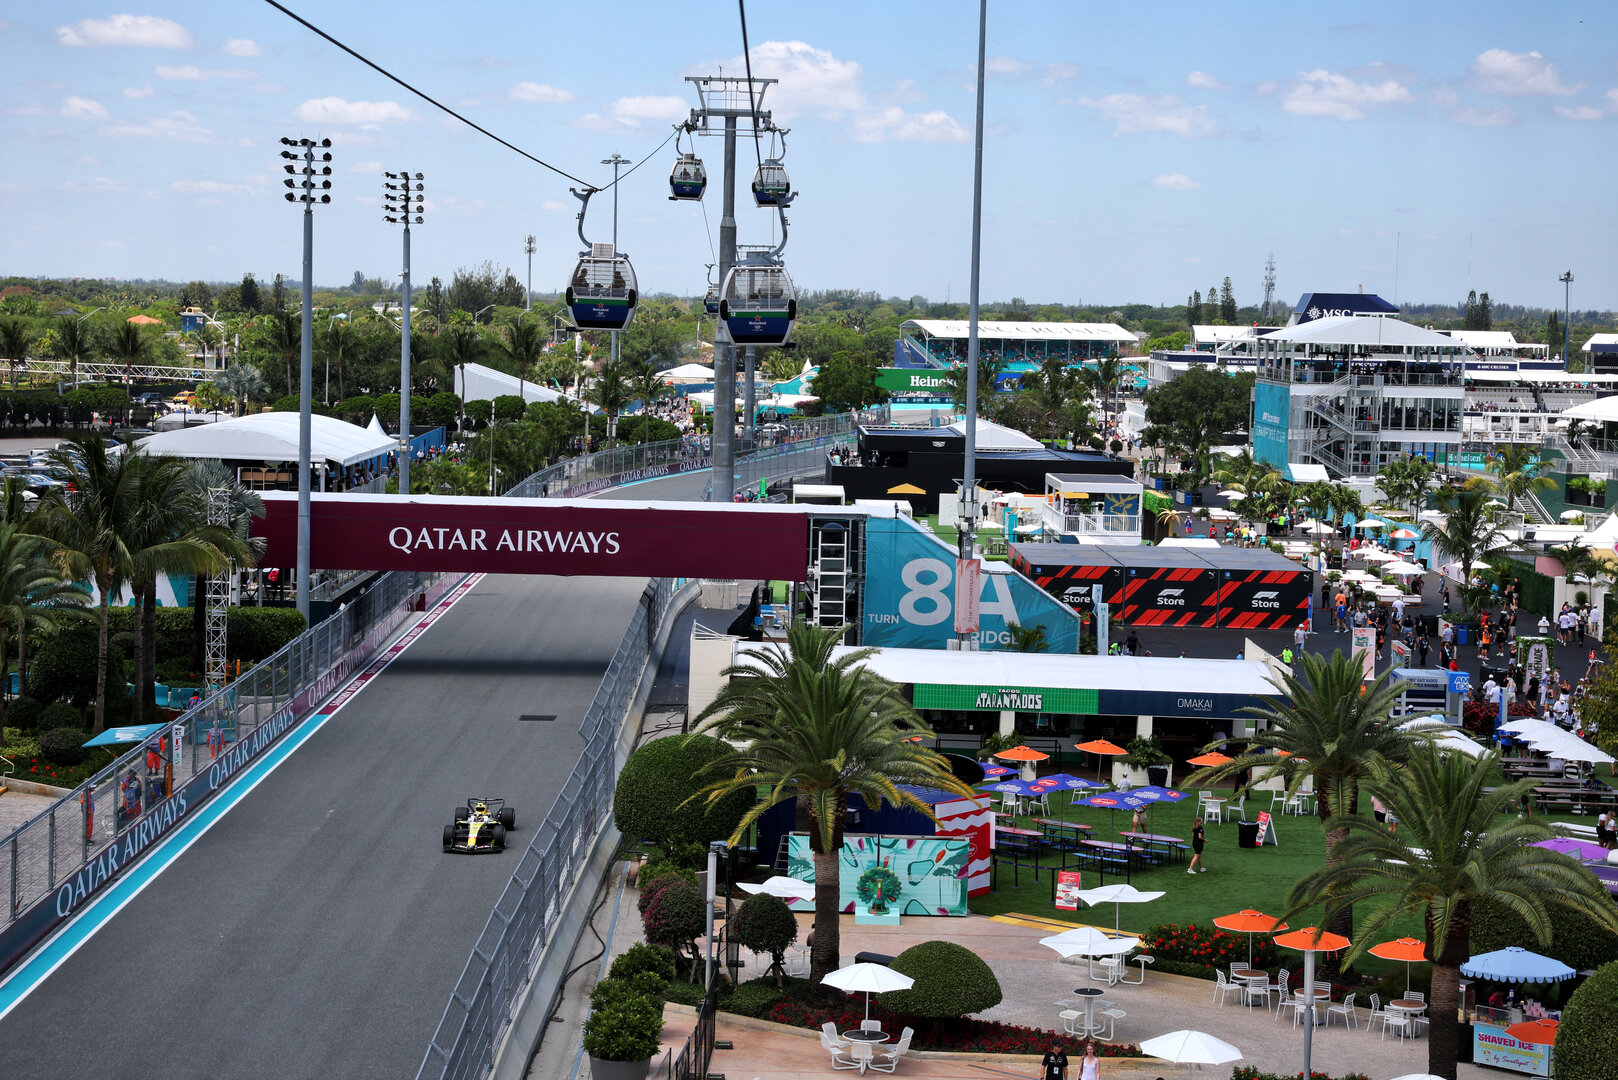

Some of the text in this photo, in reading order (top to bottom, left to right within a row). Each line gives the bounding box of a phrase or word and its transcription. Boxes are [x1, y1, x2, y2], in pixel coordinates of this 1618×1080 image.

[1323, 308, 1351, 317] MSC
[679, 459, 701, 472] QATAR
[620, 466, 669, 483] QATAR AIRWAYS
[388, 526, 620, 554] QATAR AIRWAYS
[1063, 595, 1091, 603] Store
[1157, 597, 1185, 606] Store
[1251, 599, 1280, 608] Store
[868, 613, 900, 625] TURN
[1454, 676, 1470, 684] AM
[308, 670, 337, 707] QATAR
[975, 692, 1043, 709] ATARANTADOS
[1177, 698, 1213, 708] OMAKAI
[209, 703, 294, 791] QATAR AIRWAYS
[56, 789, 187, 918] QATAR AIRWAYS
[1478, 1033, 1516, 1047] SHAVED
[1518, 1041, 1535, 1051] ICE
[1506, 1047, 1545, 1060] LEMONADE
